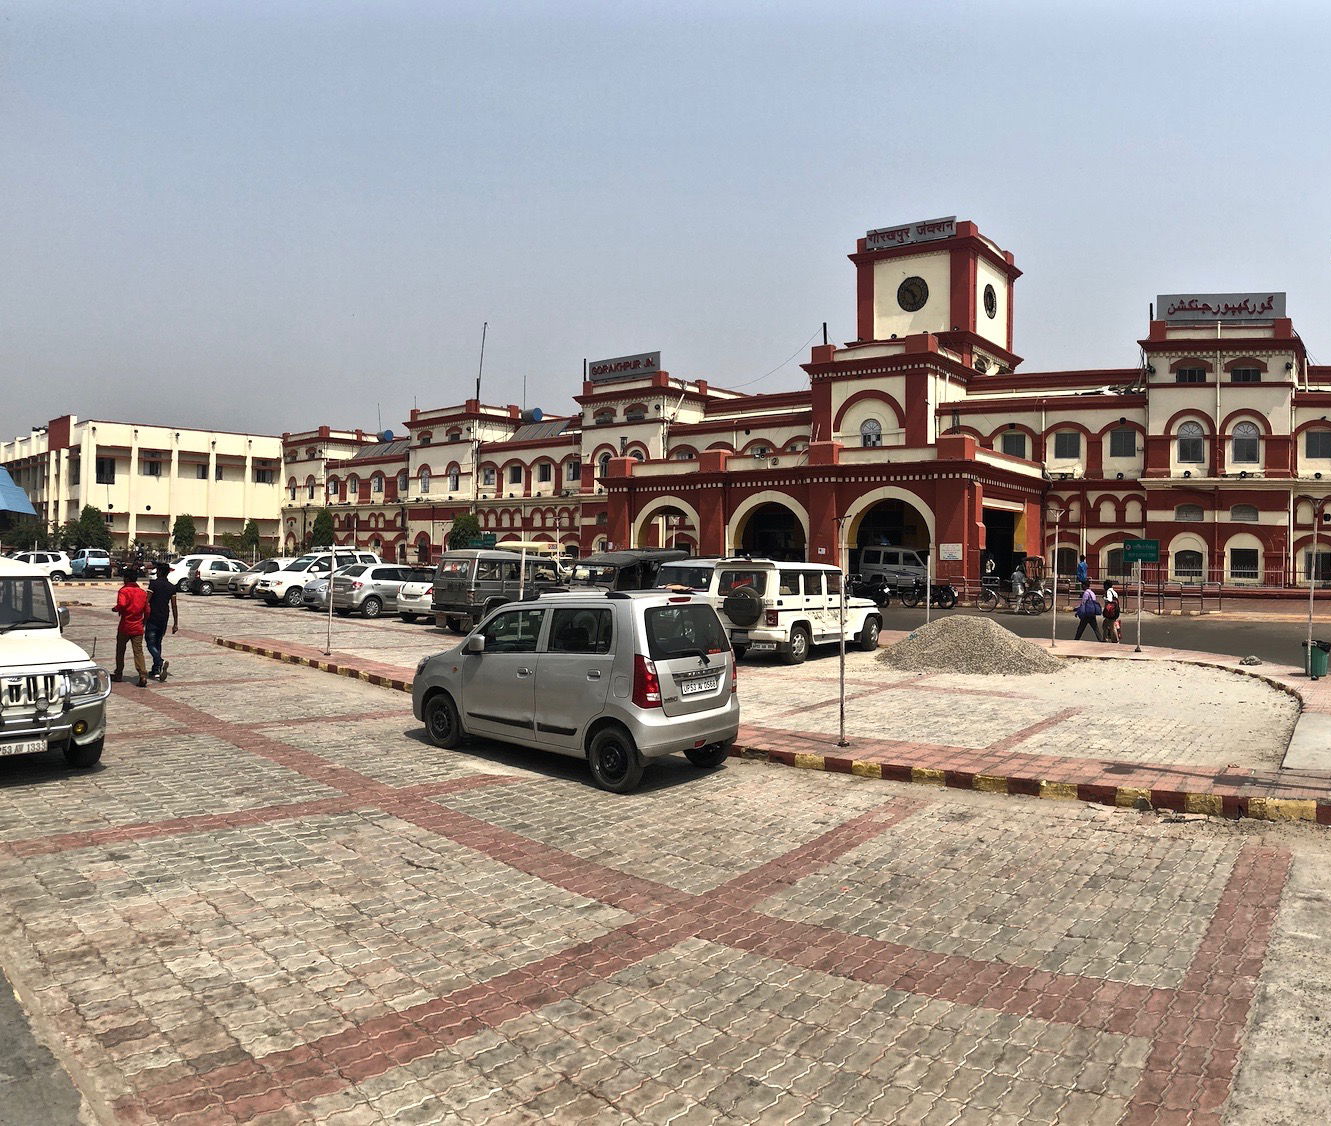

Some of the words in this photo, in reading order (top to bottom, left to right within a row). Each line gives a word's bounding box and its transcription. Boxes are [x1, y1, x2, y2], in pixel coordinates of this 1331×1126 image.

[867, 229, 910, 243] गोरखपुर
[916, 220, 954, 235] जंक्शन
[592, 360, 641, 376] GORAKHPUR
[27, 741, 46, 752] 1333
